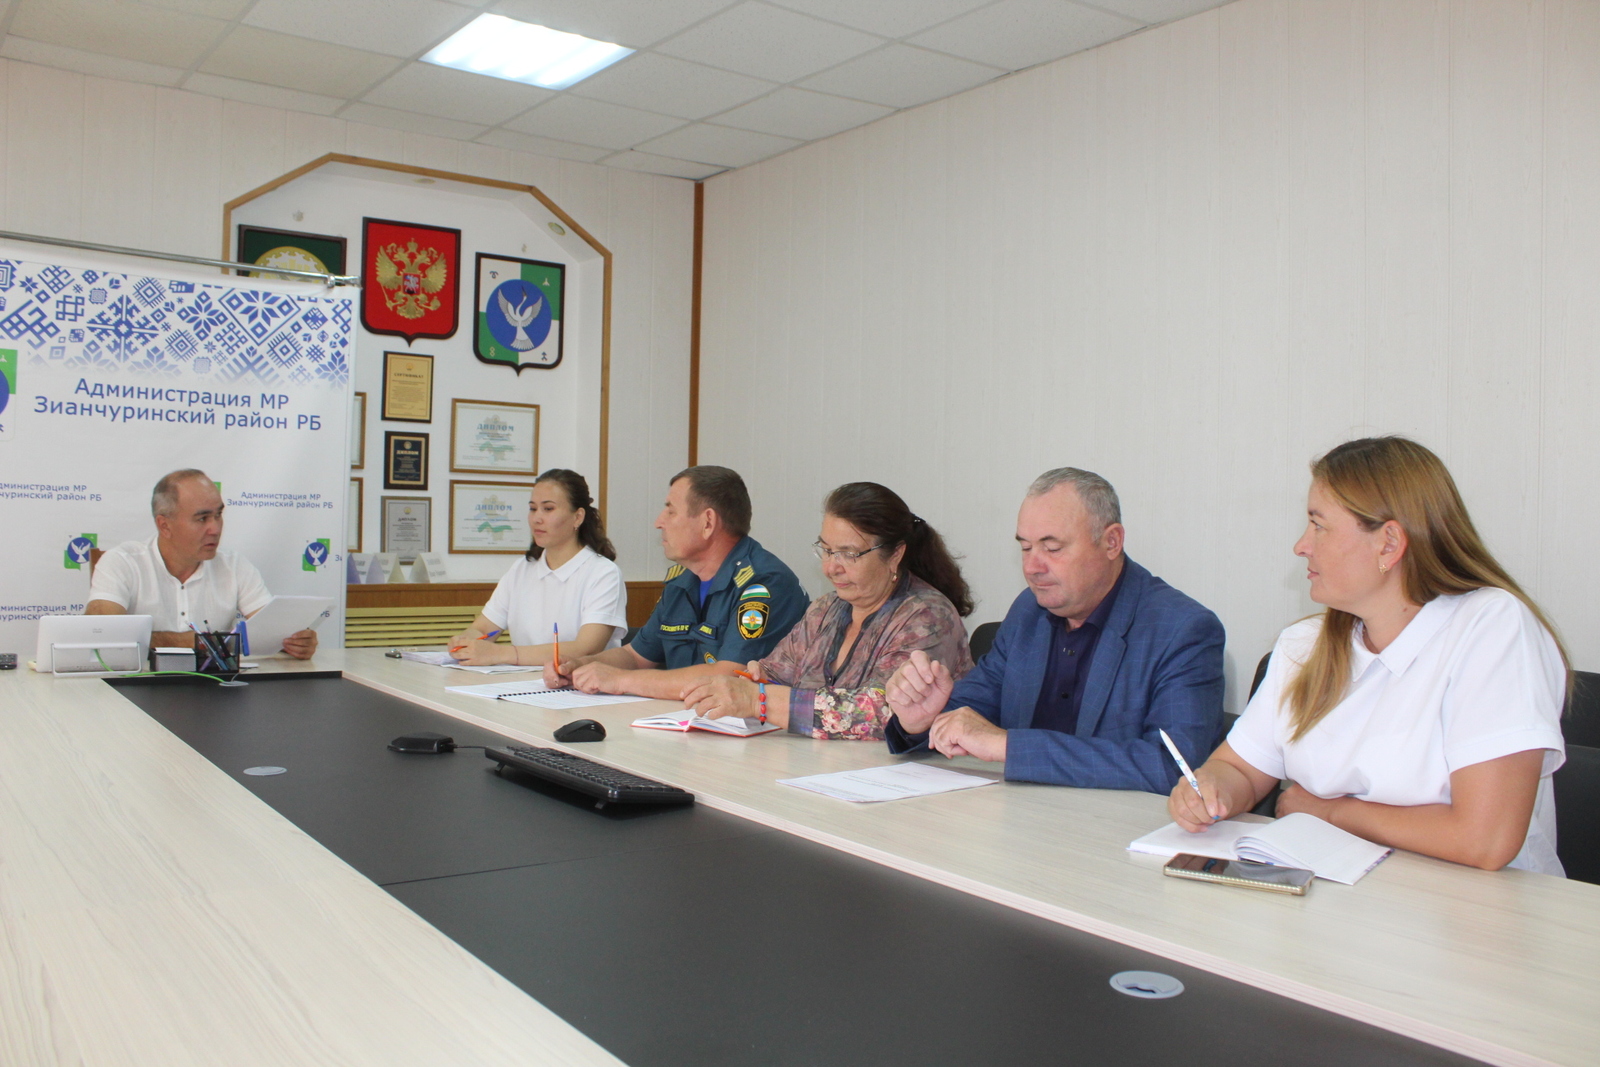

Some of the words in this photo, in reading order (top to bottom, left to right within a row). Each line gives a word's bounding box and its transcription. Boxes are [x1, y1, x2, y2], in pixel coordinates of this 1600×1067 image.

[74, 378, 251, 408] Администрация
[260, 393, 289, 409] МР
[34, 396, 215, 425] Зианчуринский
[224, 411, 287, 430] район
[297, 414, 322, 431] РБ
[477, 423, 514, 431] ДИПЛОМ
[57, 493, 86, 501] район
[241, 491, 307, 501] Администрация
[227, 499, 294, 508] Зианчуринский
[296, 501, 320, 509] район
